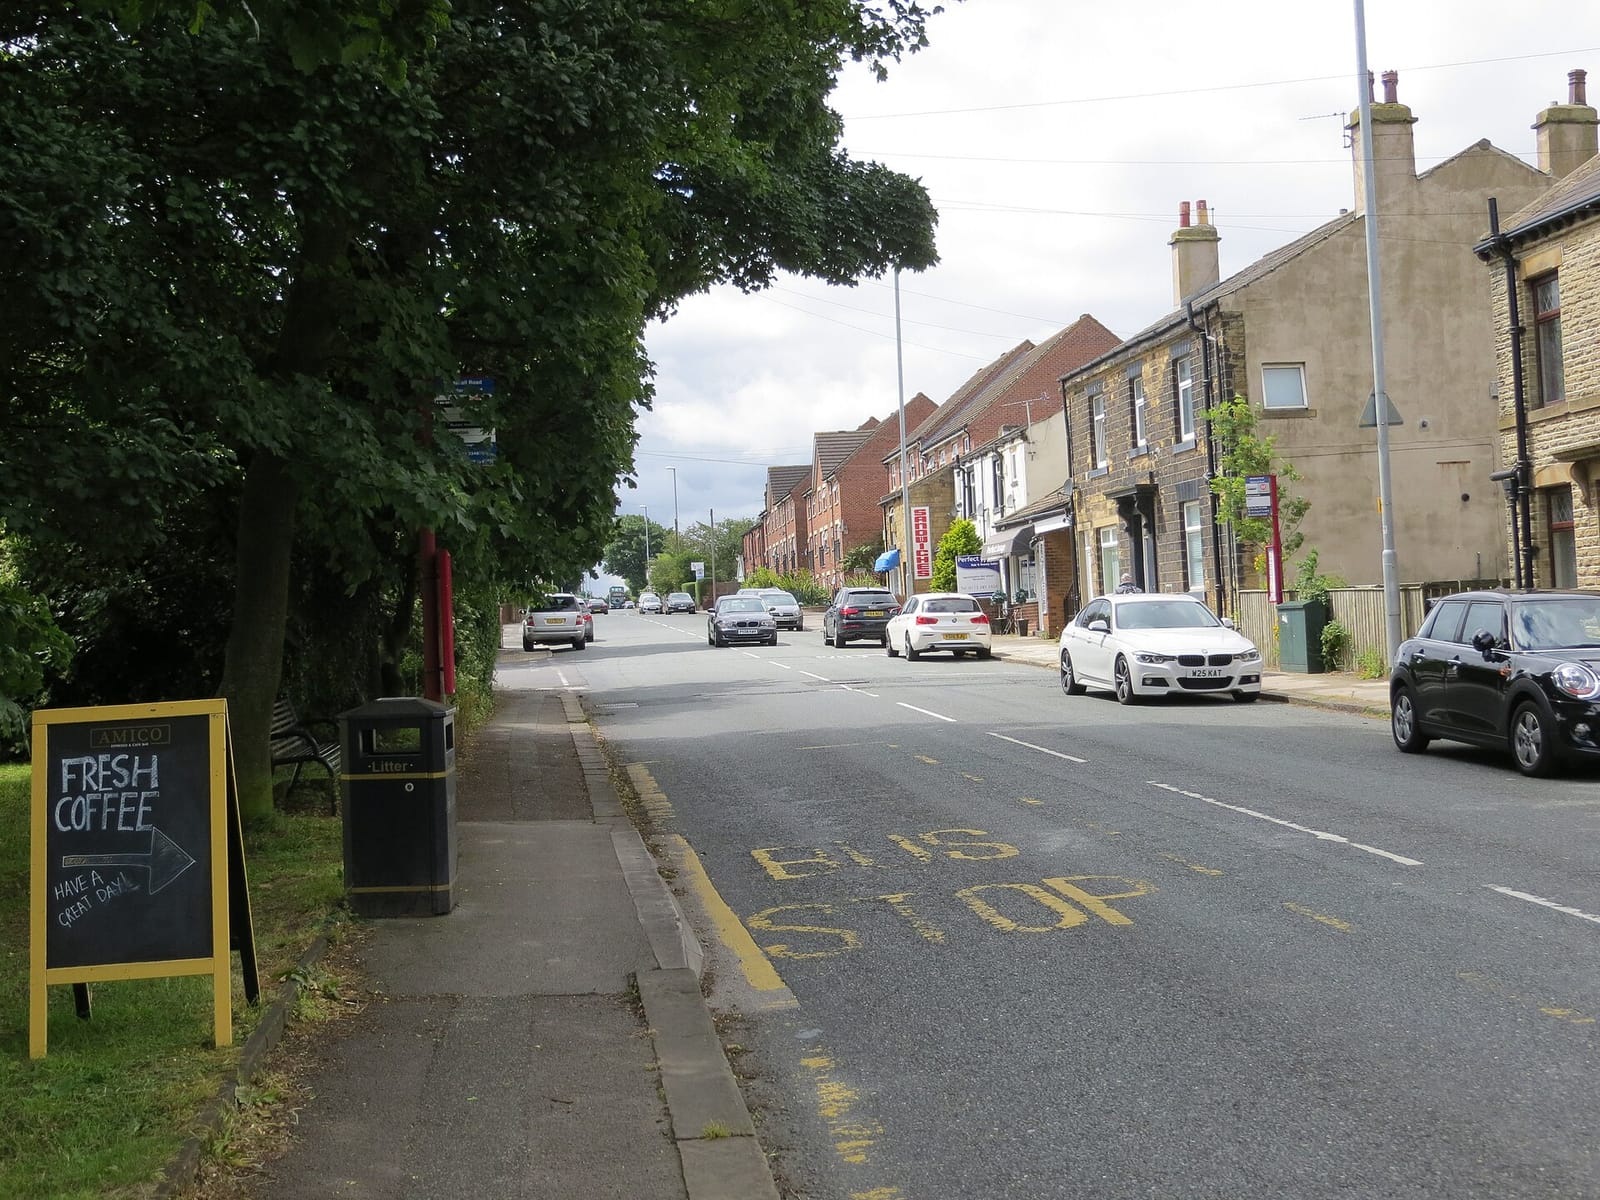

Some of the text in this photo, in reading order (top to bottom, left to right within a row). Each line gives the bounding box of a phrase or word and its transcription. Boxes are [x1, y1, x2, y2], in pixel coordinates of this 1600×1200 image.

[914, 509, 930, 577] SANDWICHES
[1208, 669, 1222, 677] KAT
[99, 727, 162, 744] AMICO
[62, 754, 159, 793] FRESH
[371, 760, 408, 773] Litter
[54, 791, 160, 832] COFFEE
[751, 829, 1020, 881] BUS
[54, 870, 104, 900] HAVE A
[58, 895, 93, 928] GREAT
[747, 875, 1157, 959] STOP
